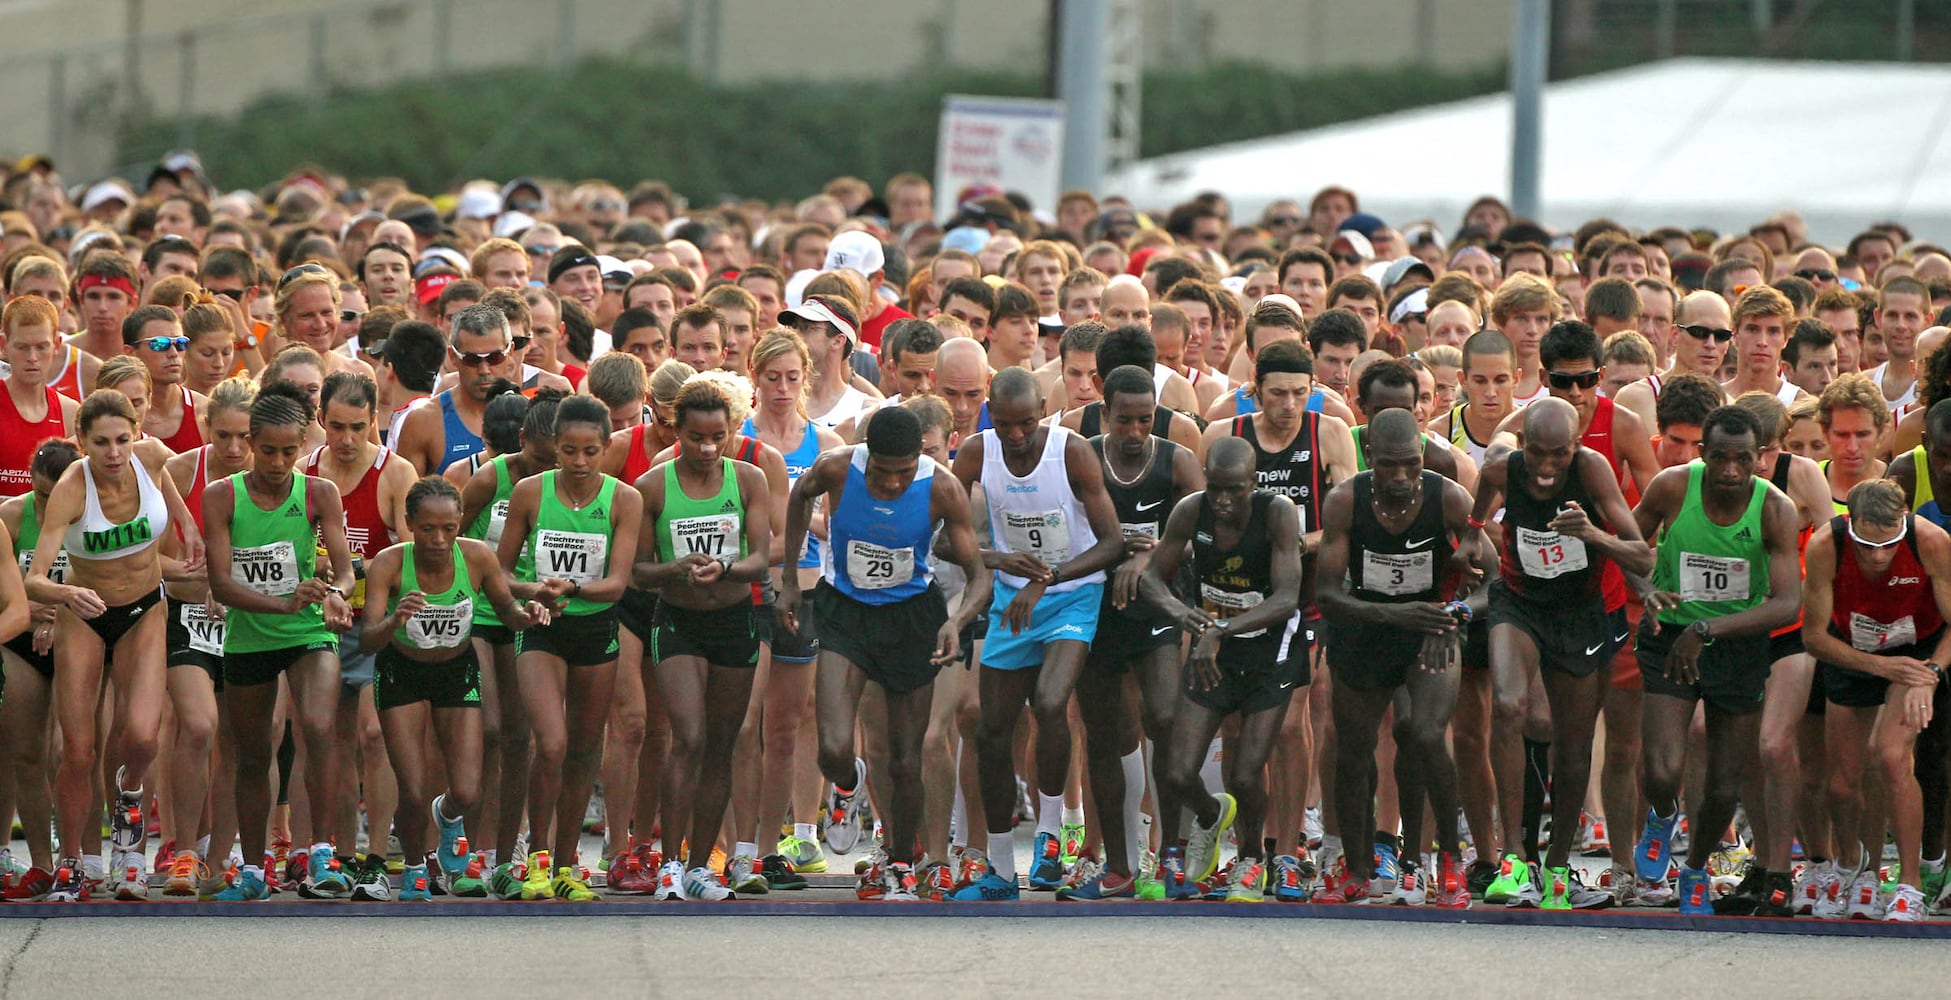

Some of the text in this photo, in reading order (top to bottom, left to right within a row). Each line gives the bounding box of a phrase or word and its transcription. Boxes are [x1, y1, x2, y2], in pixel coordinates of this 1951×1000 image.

[1256, 470, 1292, 483] new
[1006, 485, 1038, 493] Reebok
[1258, 485, 1309, 497] lance
[677, 520, 719, 530] Peachtree
[677, 528, 697, 536] Road
[83, 521, 149, 552] W111
[544, 535, 585, 544] Peachtree
[686, 534, 725, 555] W7
[1028, 530, 1042, 548] 9
[233, 550, 273, 558] Peachtree
[550, 550, 588, 573] W1
[1538, 545, 1564, 566] 13
[242, 562, 284, 583] W8
[866, 560, 893, 578] 29
[1390, 569, 1404, 585] 3
[1702, 571, 1728, 590] 10
[421, 620, 460, 636] W5
